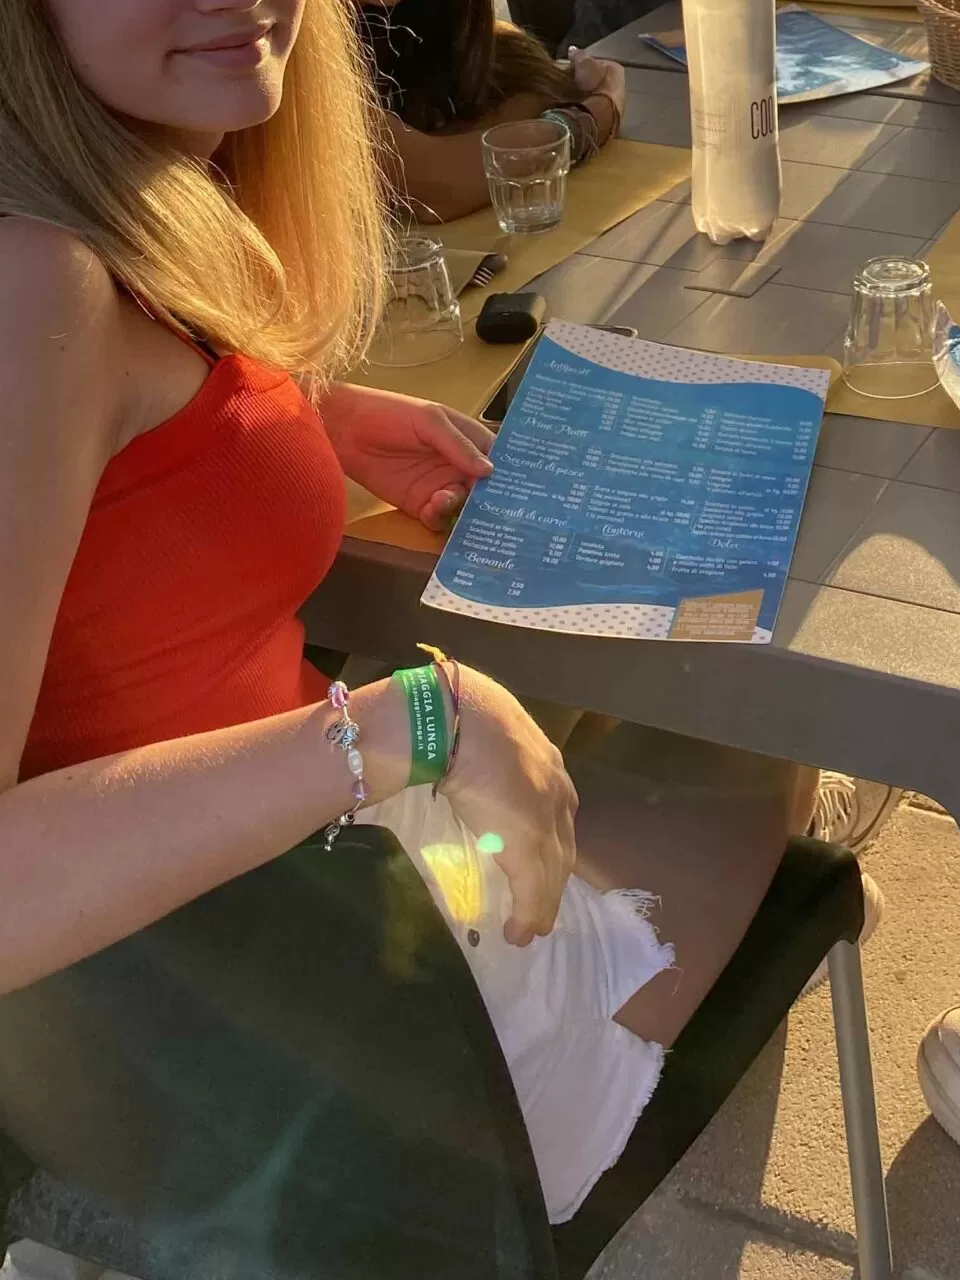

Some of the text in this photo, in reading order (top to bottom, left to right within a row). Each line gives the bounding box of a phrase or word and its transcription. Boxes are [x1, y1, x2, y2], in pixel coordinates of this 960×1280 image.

[500, 452, 586, 481] Secondi di pesce
[479, 501, 569, 528] Secondi di carne
[465, 550, 516, 570] Bevande
[414, 667, 437, 761] PIAGGIA LUNGA
